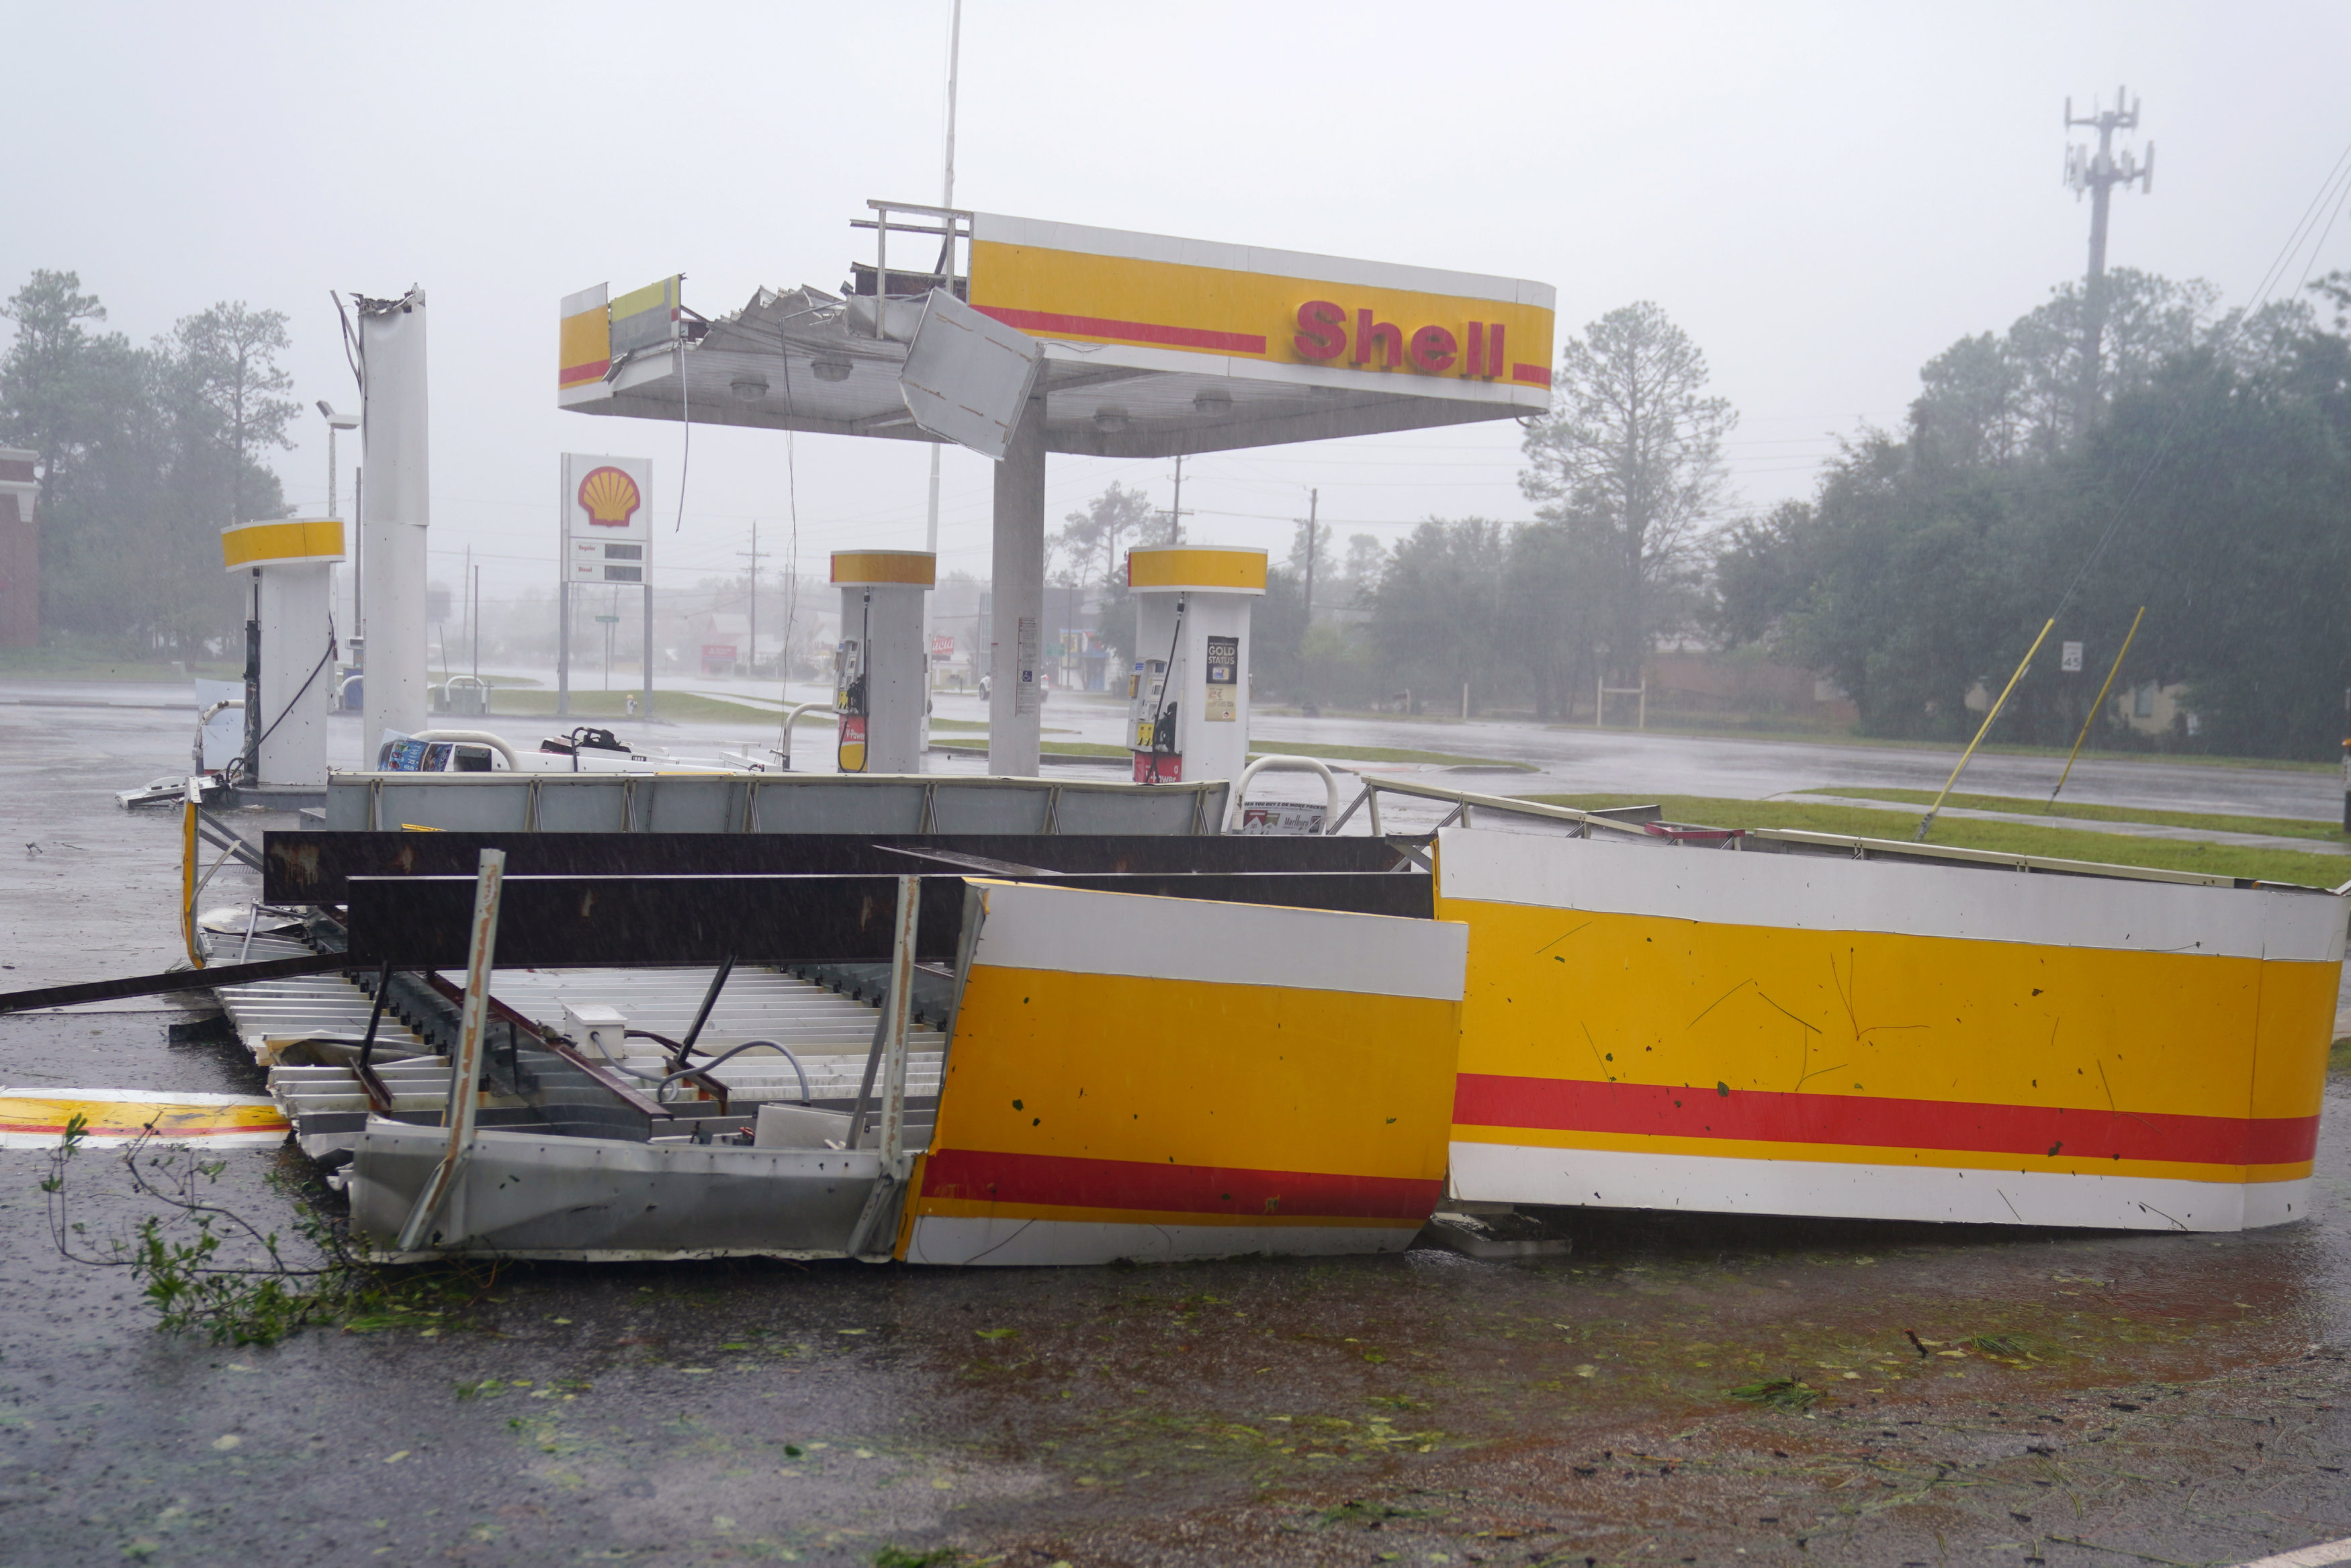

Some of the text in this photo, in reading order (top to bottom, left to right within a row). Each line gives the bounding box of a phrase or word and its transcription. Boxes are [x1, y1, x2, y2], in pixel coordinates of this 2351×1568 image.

[1294, 300, 1505, 377] Shell
[1209, 646, 1235, 655] GOLD
[1208, 656, 1235, 664] STATUS
[2064, 657, 2080, 667] 45
[1285, 815, 1309, 827] Marlboro
